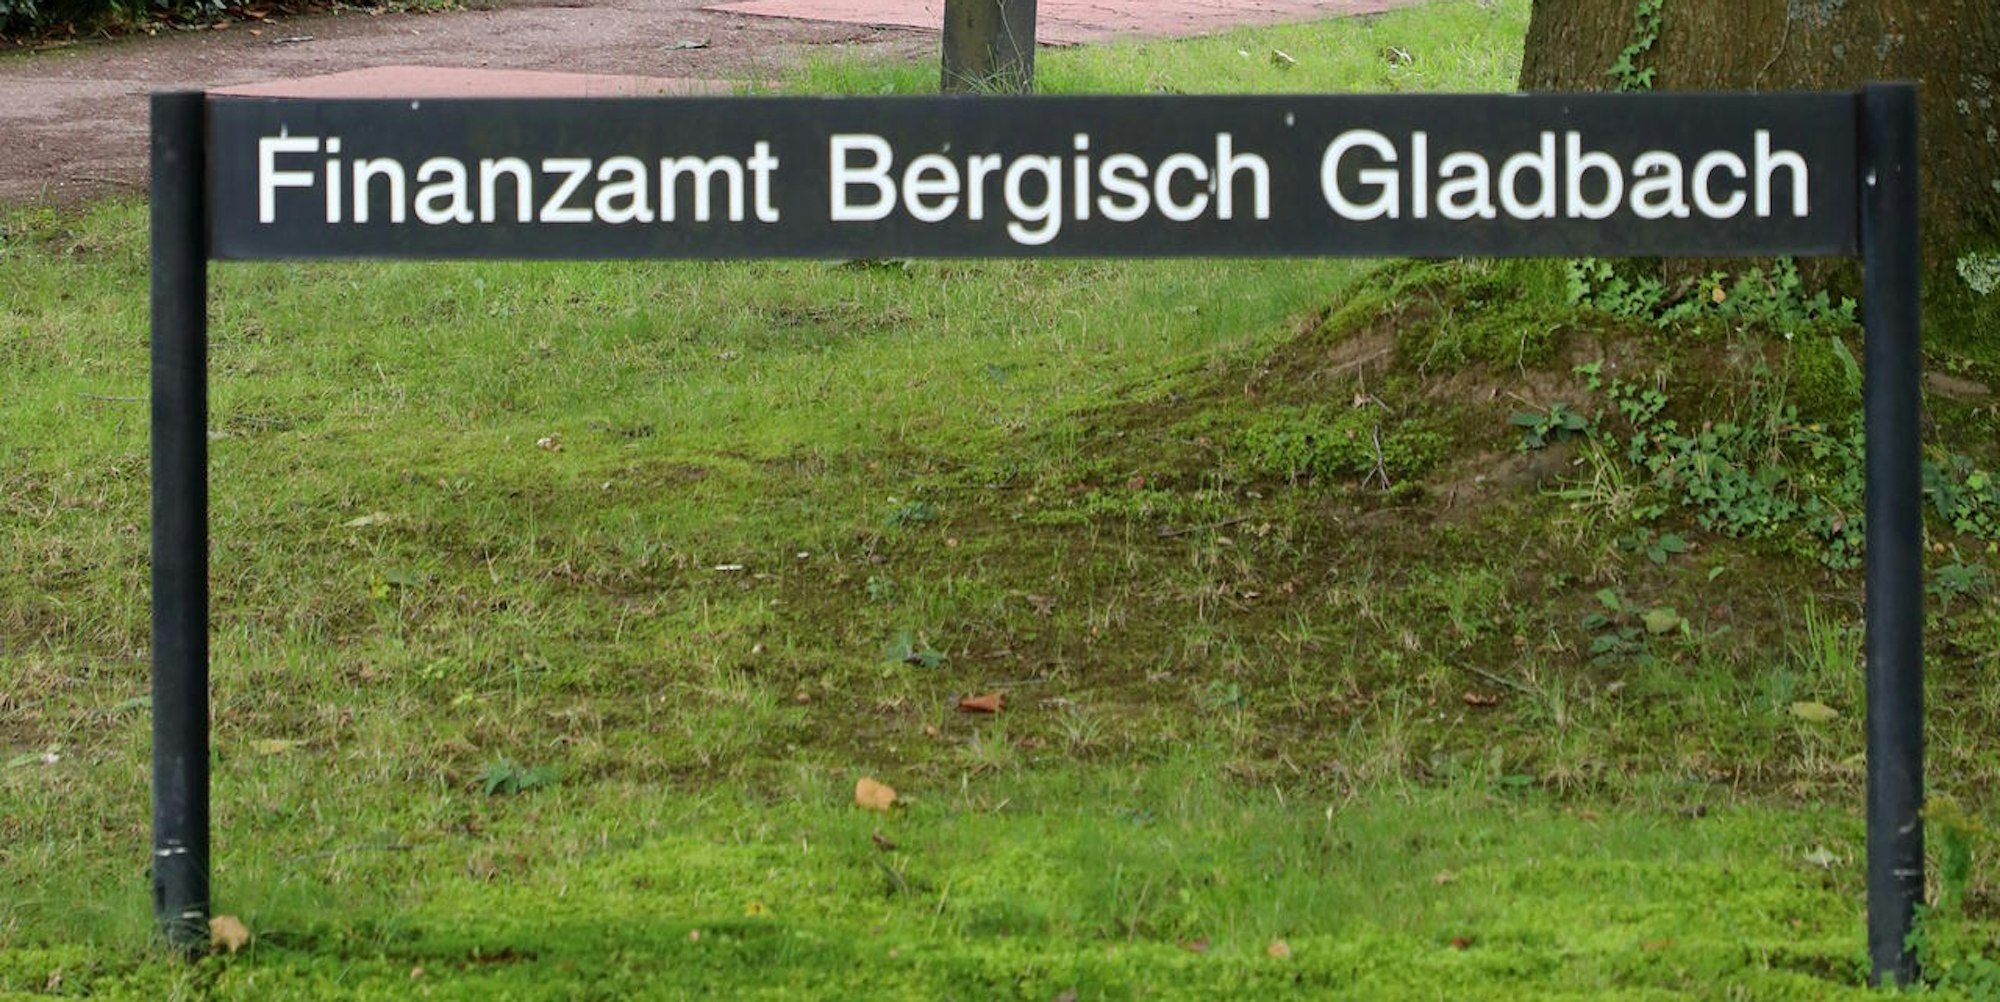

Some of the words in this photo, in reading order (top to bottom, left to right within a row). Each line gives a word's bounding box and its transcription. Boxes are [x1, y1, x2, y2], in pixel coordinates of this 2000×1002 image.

[257, 135, 780, 225] Finanzamt
[829, 132, 1271, 246] Bergisch
[1319, 129, 1810, 221] Gladbach
